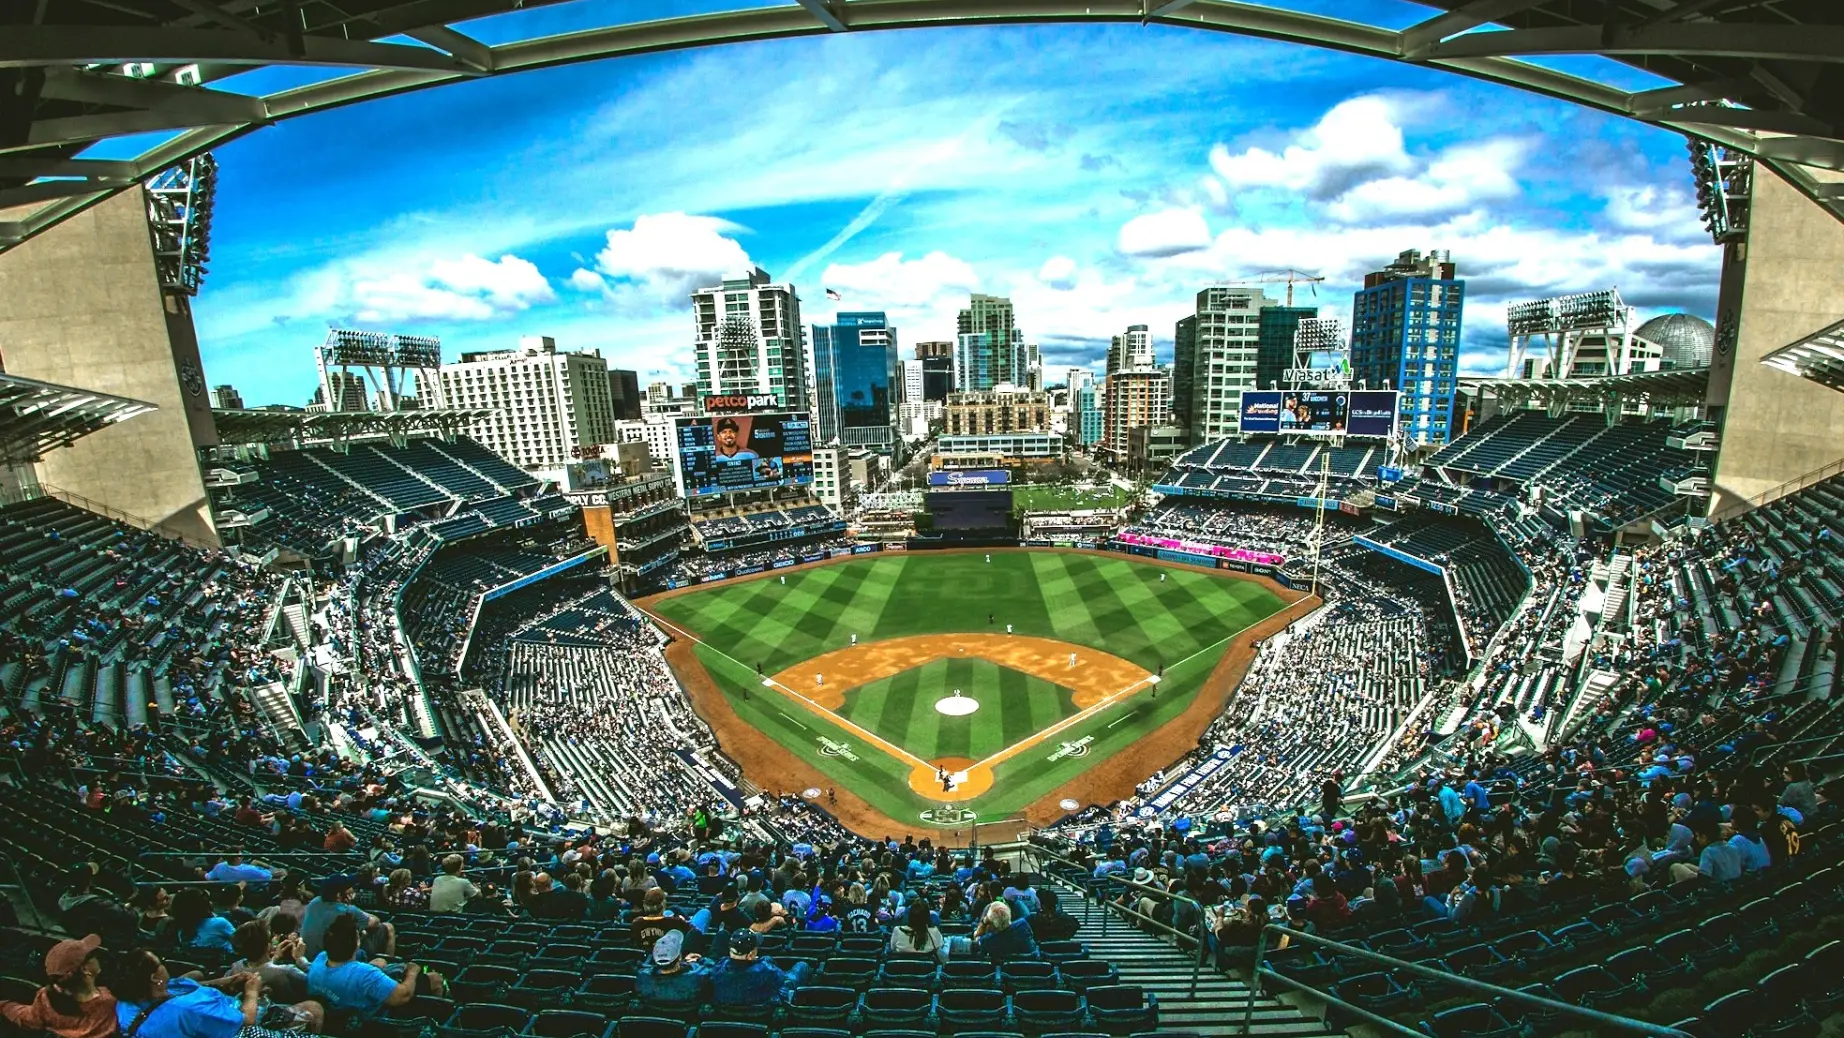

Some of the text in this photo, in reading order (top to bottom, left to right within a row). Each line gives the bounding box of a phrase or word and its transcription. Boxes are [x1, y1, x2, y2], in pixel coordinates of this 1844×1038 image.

[1285, 368, 1330, 381] Viasat
[607, 489, 632, 501] WESTERN
[632, 484, 648, 495] METAL
[648, 480, 664, 491] SUPPLY
[855, 546, 871, 554] ARCO
[773, 559, 795, 568] GEICO
[1291, 583, 1310, 592] NECA
[851, 918, 868, 932] 13
